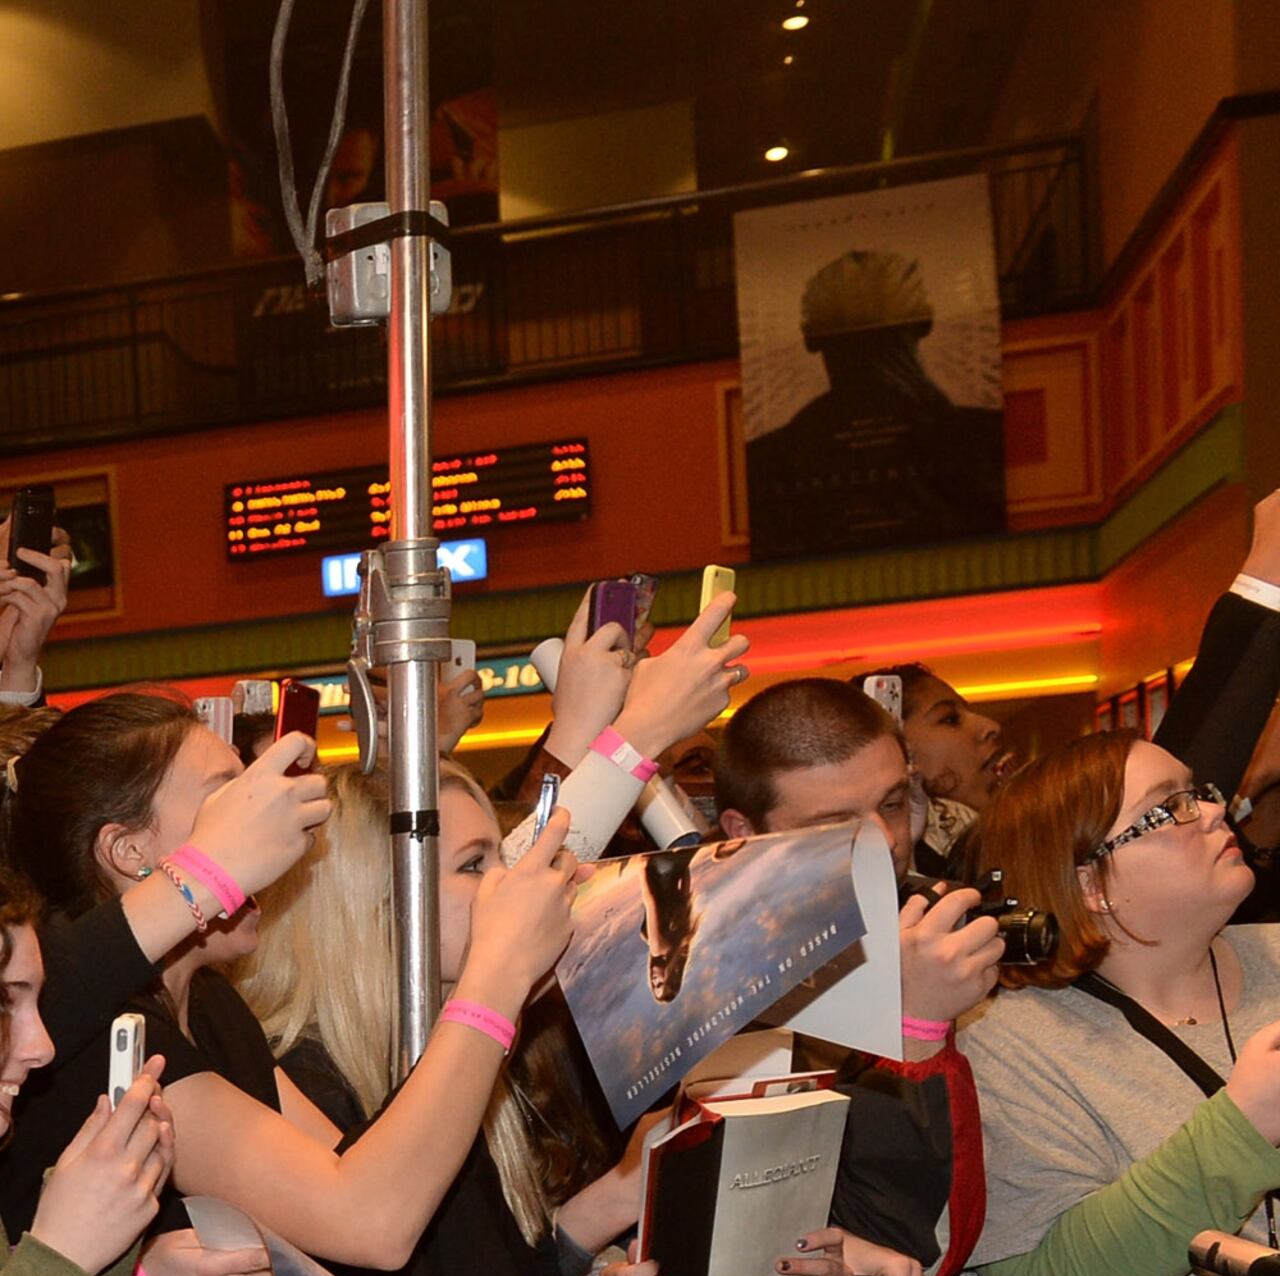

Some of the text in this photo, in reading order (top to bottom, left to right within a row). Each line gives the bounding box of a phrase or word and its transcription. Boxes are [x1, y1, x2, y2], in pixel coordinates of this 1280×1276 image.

[626, 922, 838, 1100] BASED ON THE WORLDWIDE BESTSELLER
